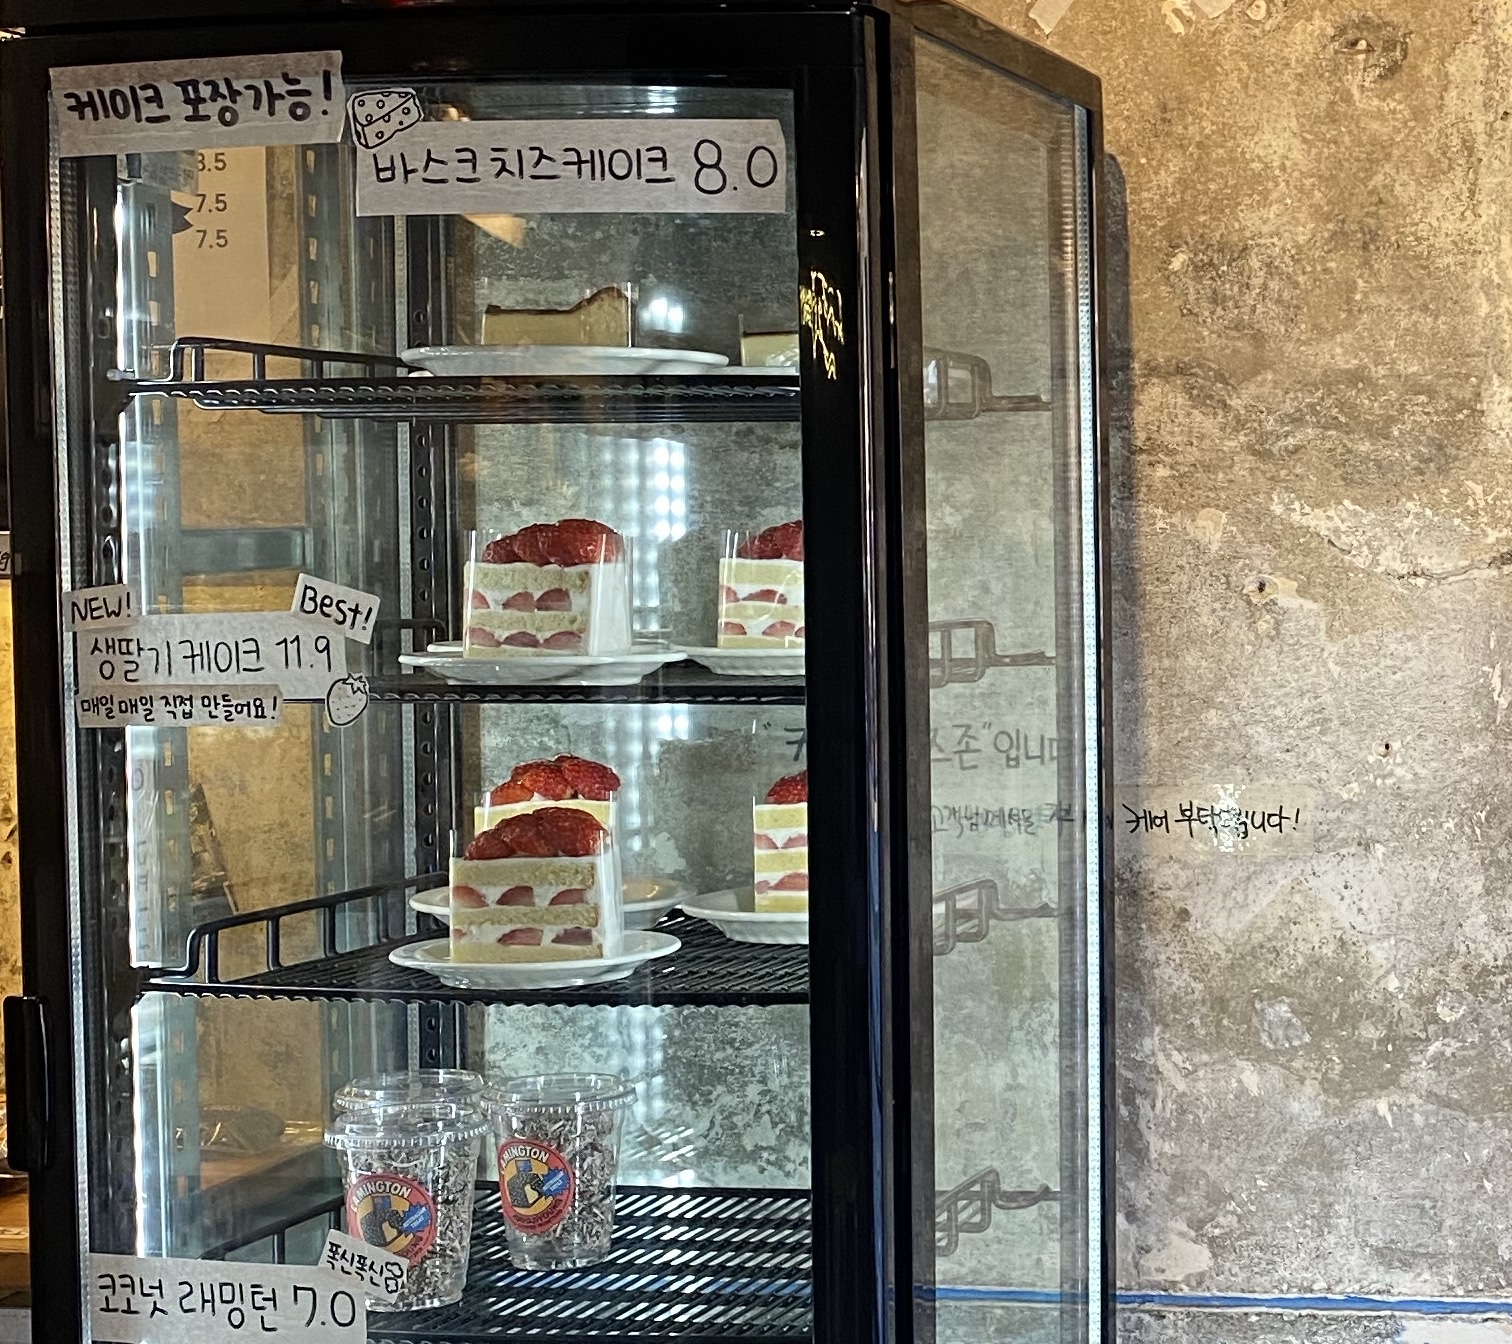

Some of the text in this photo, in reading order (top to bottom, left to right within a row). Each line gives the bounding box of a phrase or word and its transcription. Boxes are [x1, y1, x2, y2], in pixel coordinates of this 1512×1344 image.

[64, 82, 171, 124] 케이크
[694, 139, 778, 195] 8.0
[195, 193, 228, 213] 7.5
[196, 229, 228, 249] 7.5
[70, 591, 134, 624] NEW!
[274, 634, 333, 673] 11.9
[160, 693, 195, 722] 직접
[98, 1272, 357, 1334] 코코넛 래밍턴 7.0
